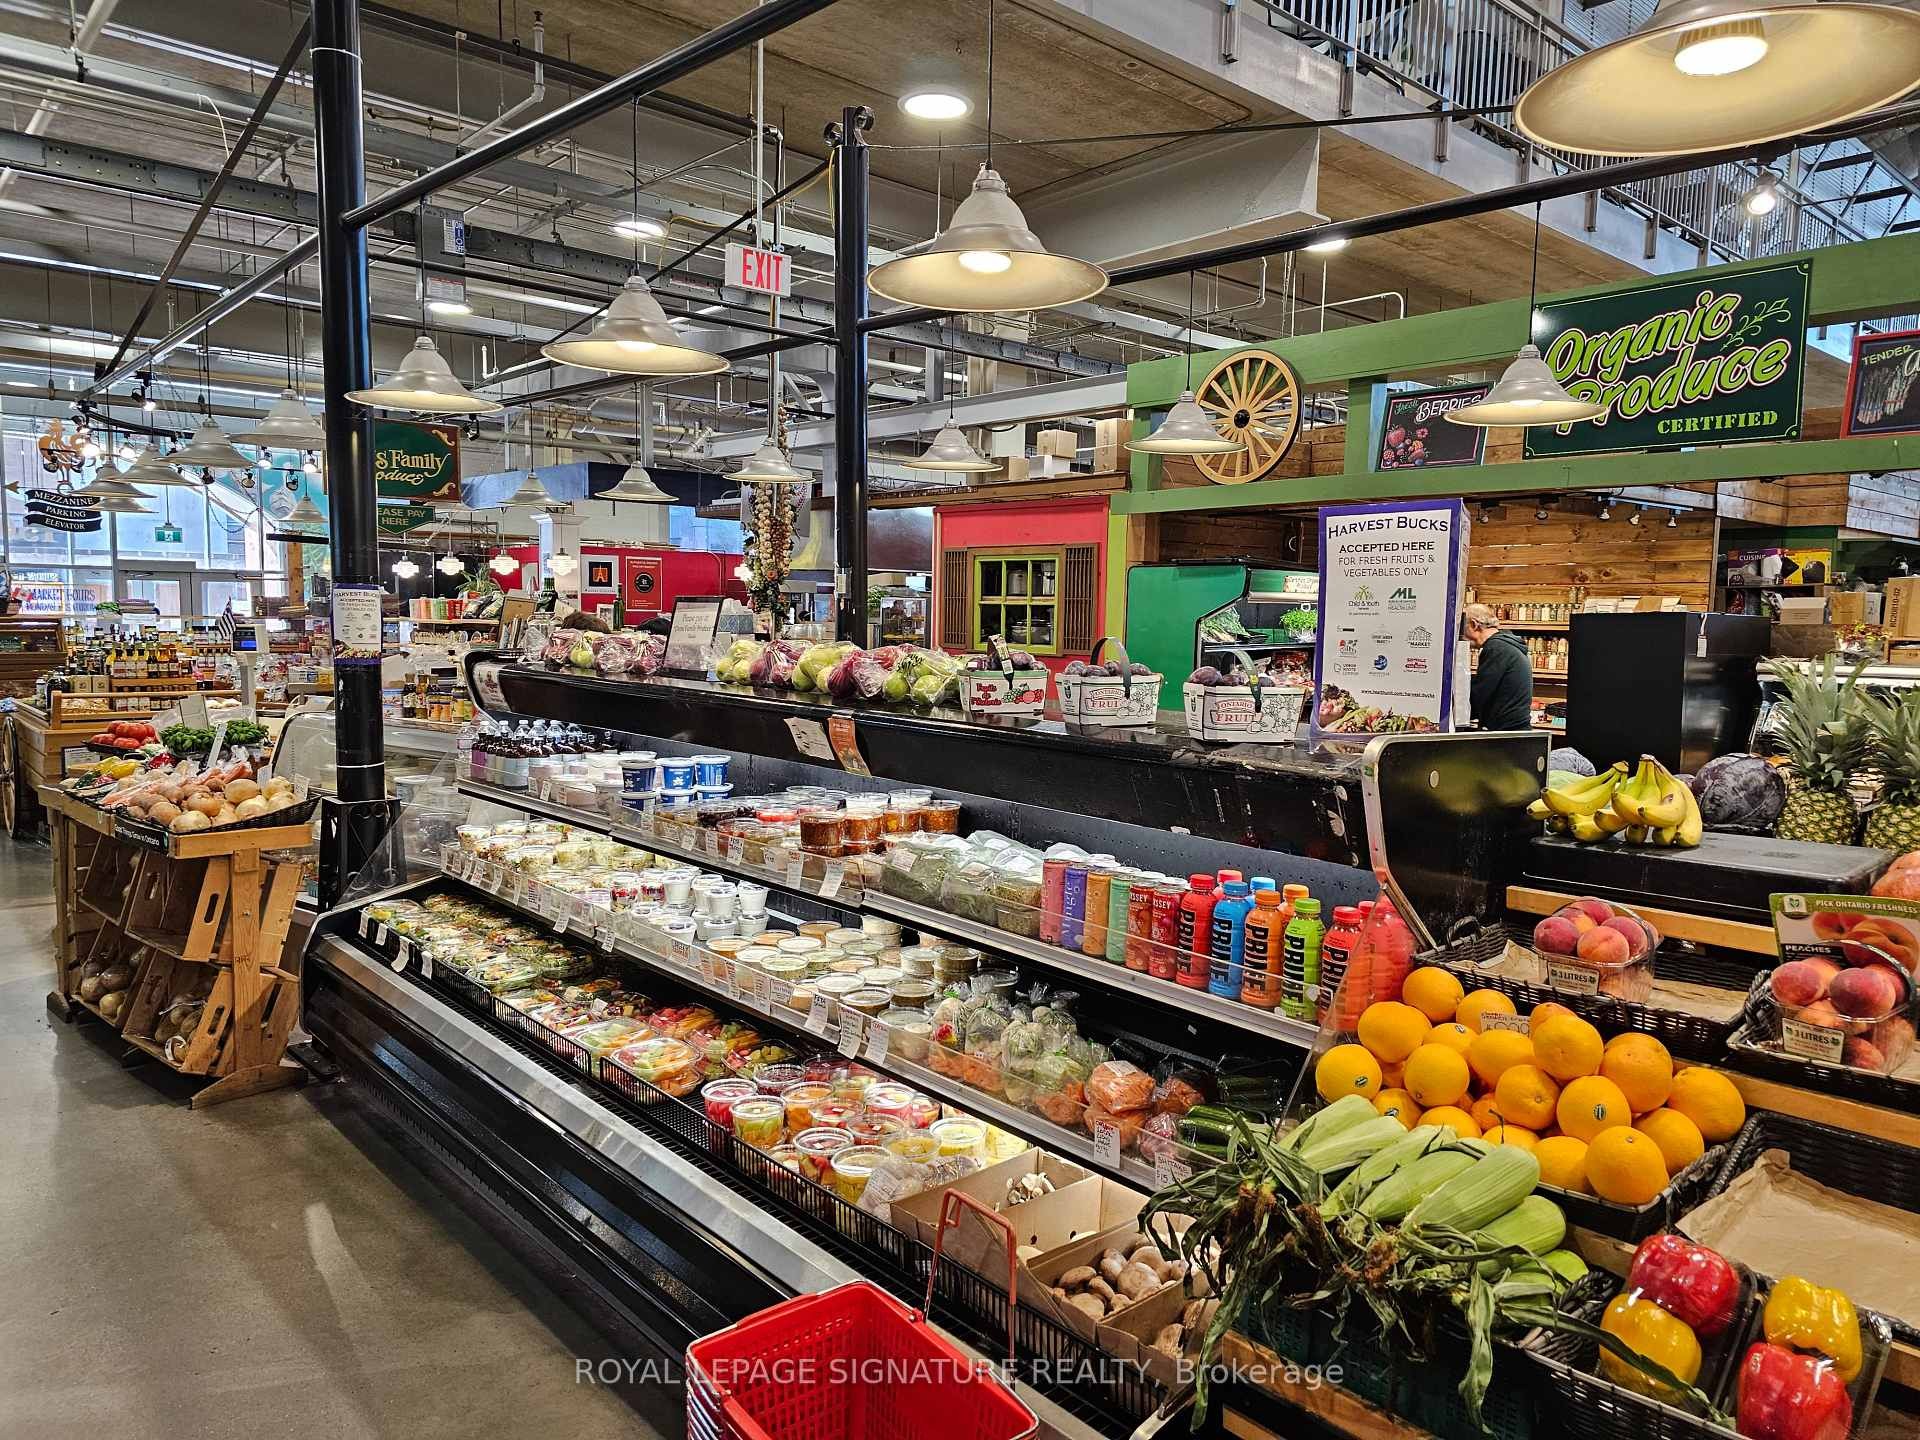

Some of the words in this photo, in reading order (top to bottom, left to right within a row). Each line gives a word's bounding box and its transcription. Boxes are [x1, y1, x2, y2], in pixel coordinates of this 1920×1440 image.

[743, 248, 783, 292] EXIT
[1545, 289, 1742, 383] Organic
[1861, 345, 1912, 366] TENDER
[1556, 339, 1791, 436] Produce
[1657, 410, 1778, 435] CERTIFIED
[389, 449, 451, 477] Family
[376, 469, 424, 485] oduce
[34, 490, 95, 505] MEZZANINE
[45, 505, 86, 518] PARKING
[377, 508, 404, 517] EASE
[407, 509, 425, 518] PAY
[44, 518, 86, 530] ELEVATOR
[382, 517, 409, 526] HERE
[1328, 518, 1393, 539] HARVEST
[1397, 516, 1449, 532] BUCKS
[1339, 543, 1399, 553] ACCEPTED
[1402, 541, 1435, 551] HERE
[1339, 557, 1356, 565] FOR
[1359, 556, 1388, 565] FRESH
[1391, 555, 1425, 564] FRUITS
[1428, 555, 1435, 563] &
[1344, 568, 1400, 577] VEGETABLES
[1403, 567, 1429, 576] ONLY
[1390, 588, 1417, 599] ML
[1091, 700, 1119, 708] FRUI
[1221, 701, 1253, 709] ONTARIO
[1216, 713, 1257, 722] FRUIT
[1836, 901, 1871, 909] ONTARIO
[1210, 918, 1233, 984] PRIME
[1785, 944, 1832, 954] PEACHES
[1243, 923, 1269, 991] PRIME
[1564, 971, 1588, 983] LITRES
[1801, 1031, 1830, 1045] LITRES
